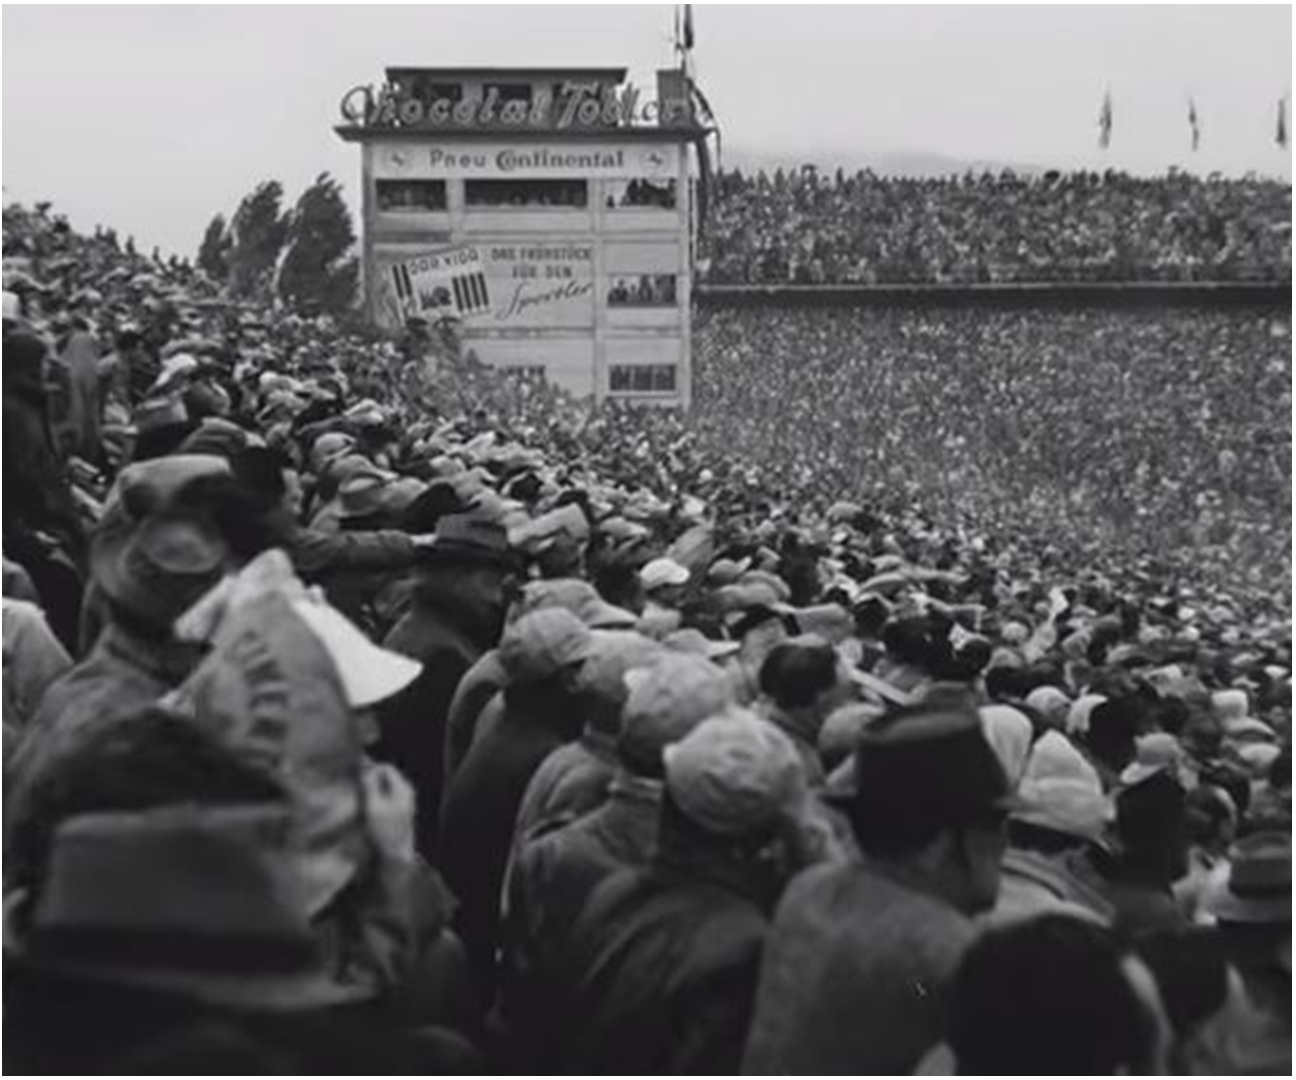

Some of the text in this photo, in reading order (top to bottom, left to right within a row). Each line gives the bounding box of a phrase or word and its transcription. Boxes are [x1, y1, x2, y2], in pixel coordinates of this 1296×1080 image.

[341, 84, 549, 125] Chocolat
[430, 149, 624, 171] Pneu Continental
